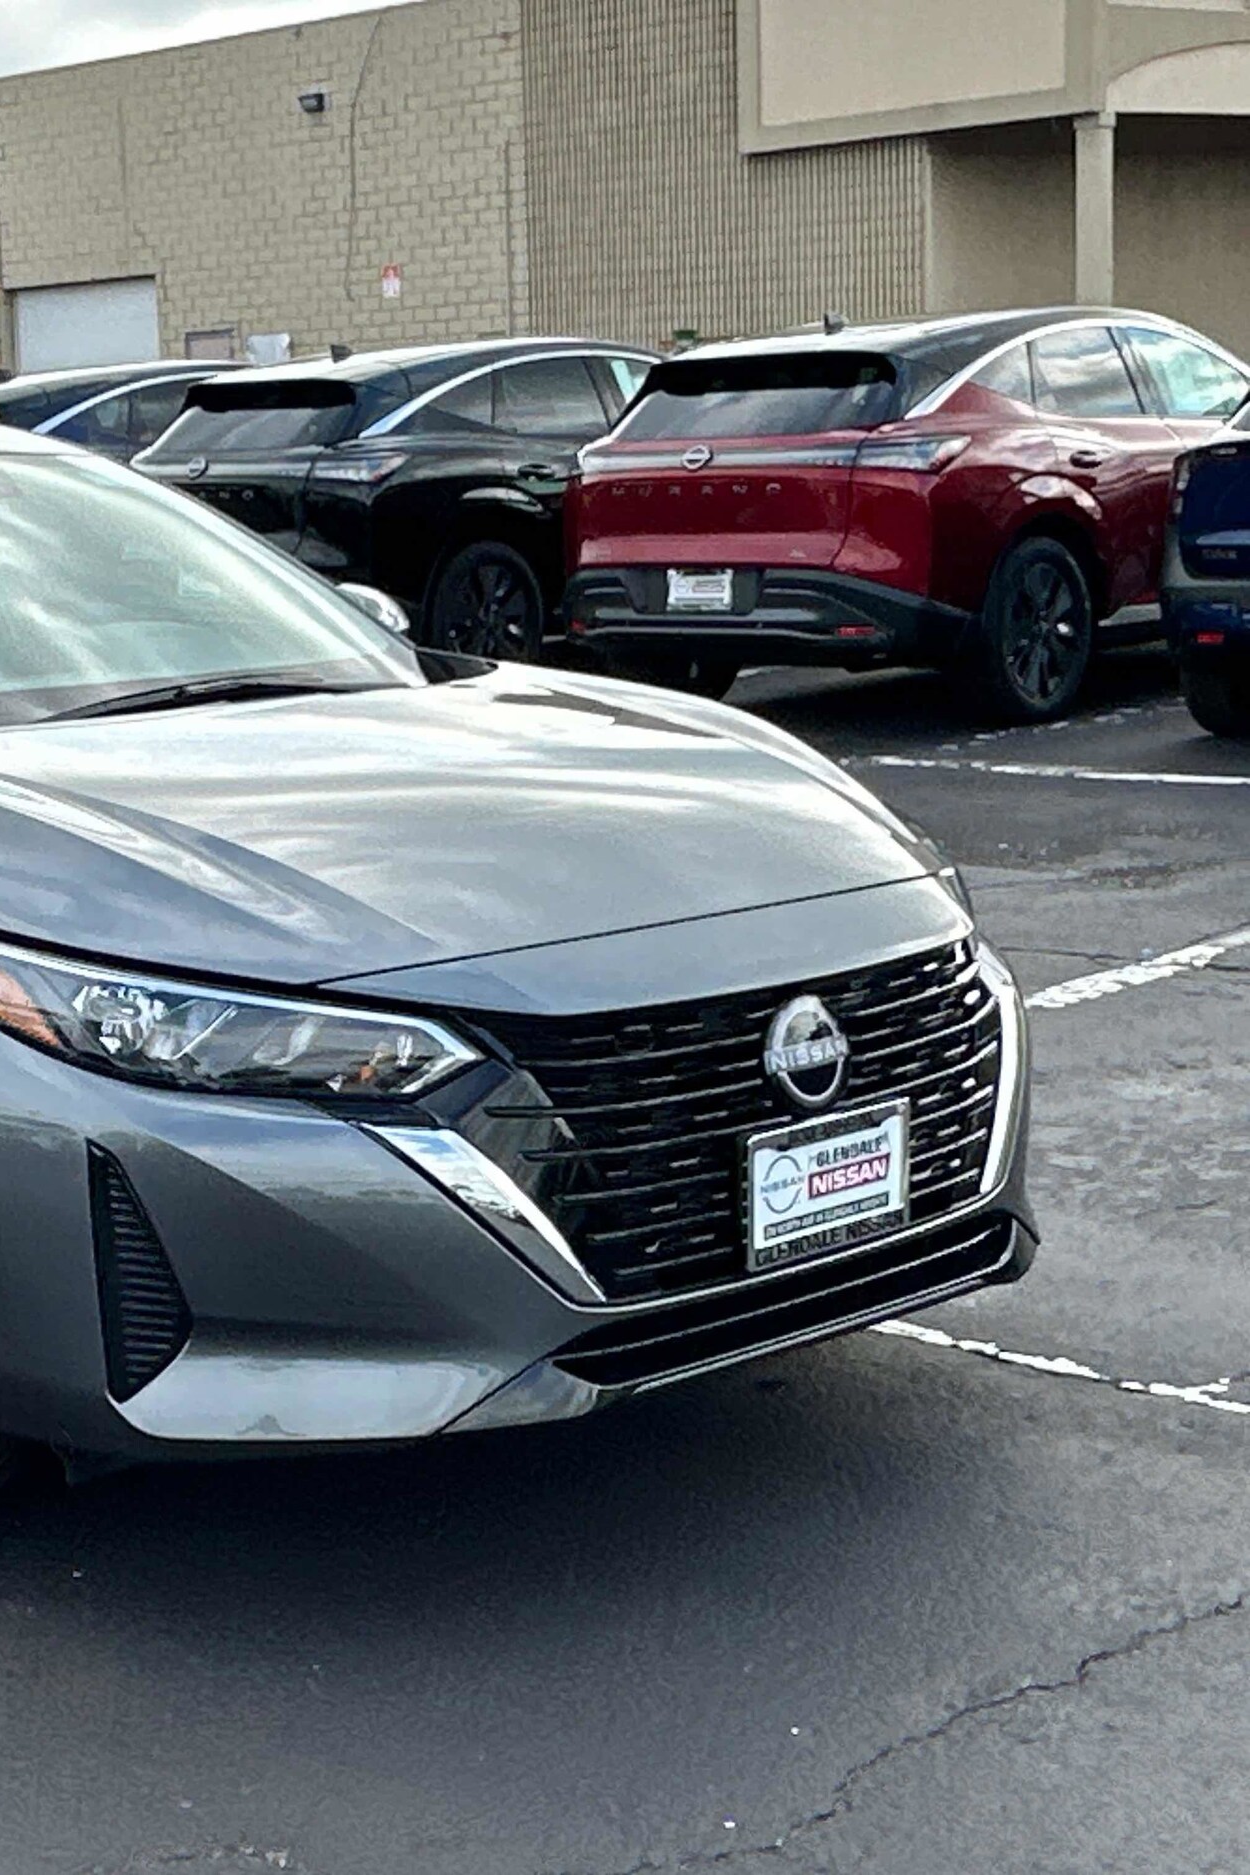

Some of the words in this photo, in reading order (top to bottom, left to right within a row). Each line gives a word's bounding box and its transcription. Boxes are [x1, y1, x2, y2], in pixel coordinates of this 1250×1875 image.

[770, 1039, 847, 1070] NISSAN
[815, 1136, 883, 1167] GLENDALE
[811, 1157, 887, 1197] NISSAN
